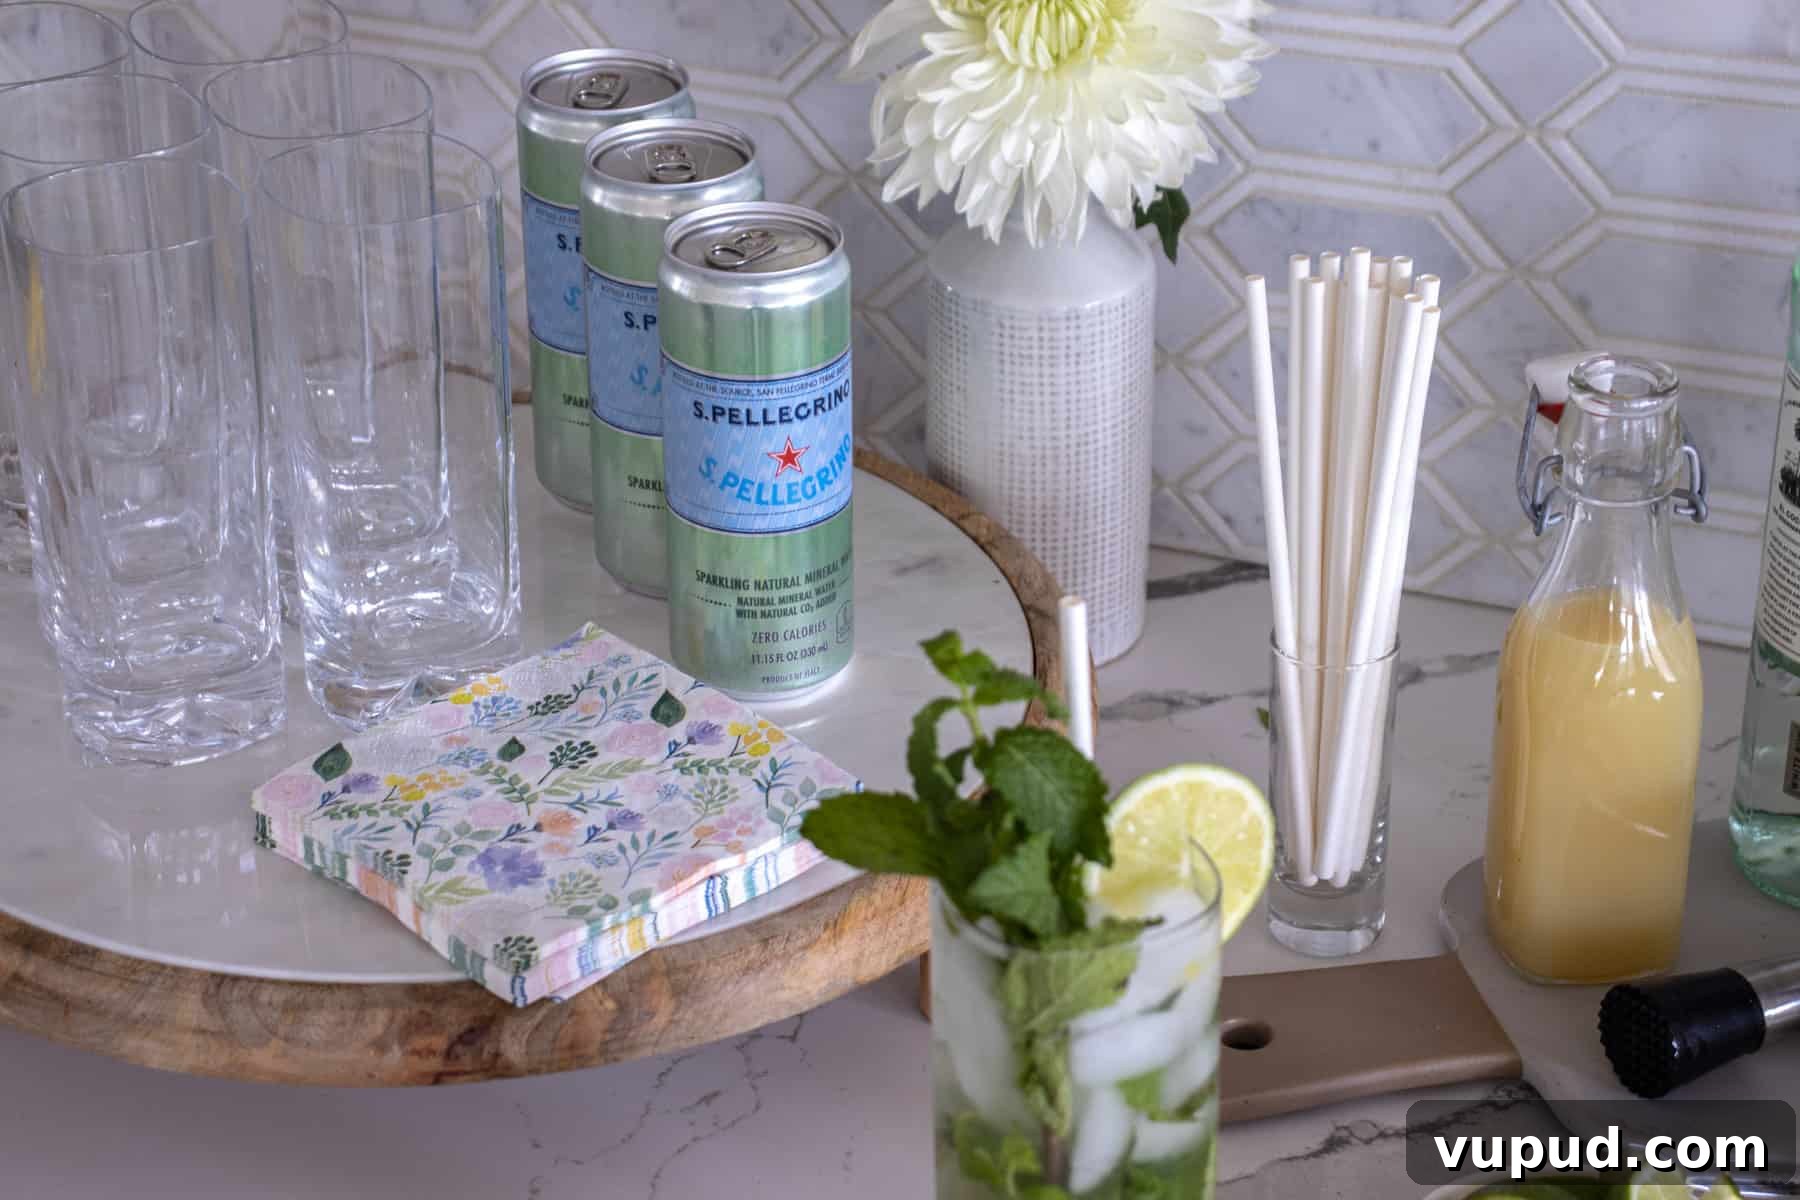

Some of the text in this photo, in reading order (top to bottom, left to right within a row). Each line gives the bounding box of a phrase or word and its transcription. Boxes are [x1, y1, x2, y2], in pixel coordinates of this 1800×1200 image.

[693, 379, 850, 426] S.PELLEGRINO
[627, 474, 662, 492] SPARKL
[695, 561, 839, 591] SPARKLING NATURAL MINERAL
[736, 595, 775, 608] NATURAL
[778, 590, 813, 605] MINERAL
[736, 607, 758, 619] WITH
[760, 605, 798, 619] NATURAL
[751, 620, 827, 644] ZERO CALORIES
[751, 653, 774, 665] 11.15
[775, 652, 785, 663] FL
[787, 650, 799, 662] OZ
